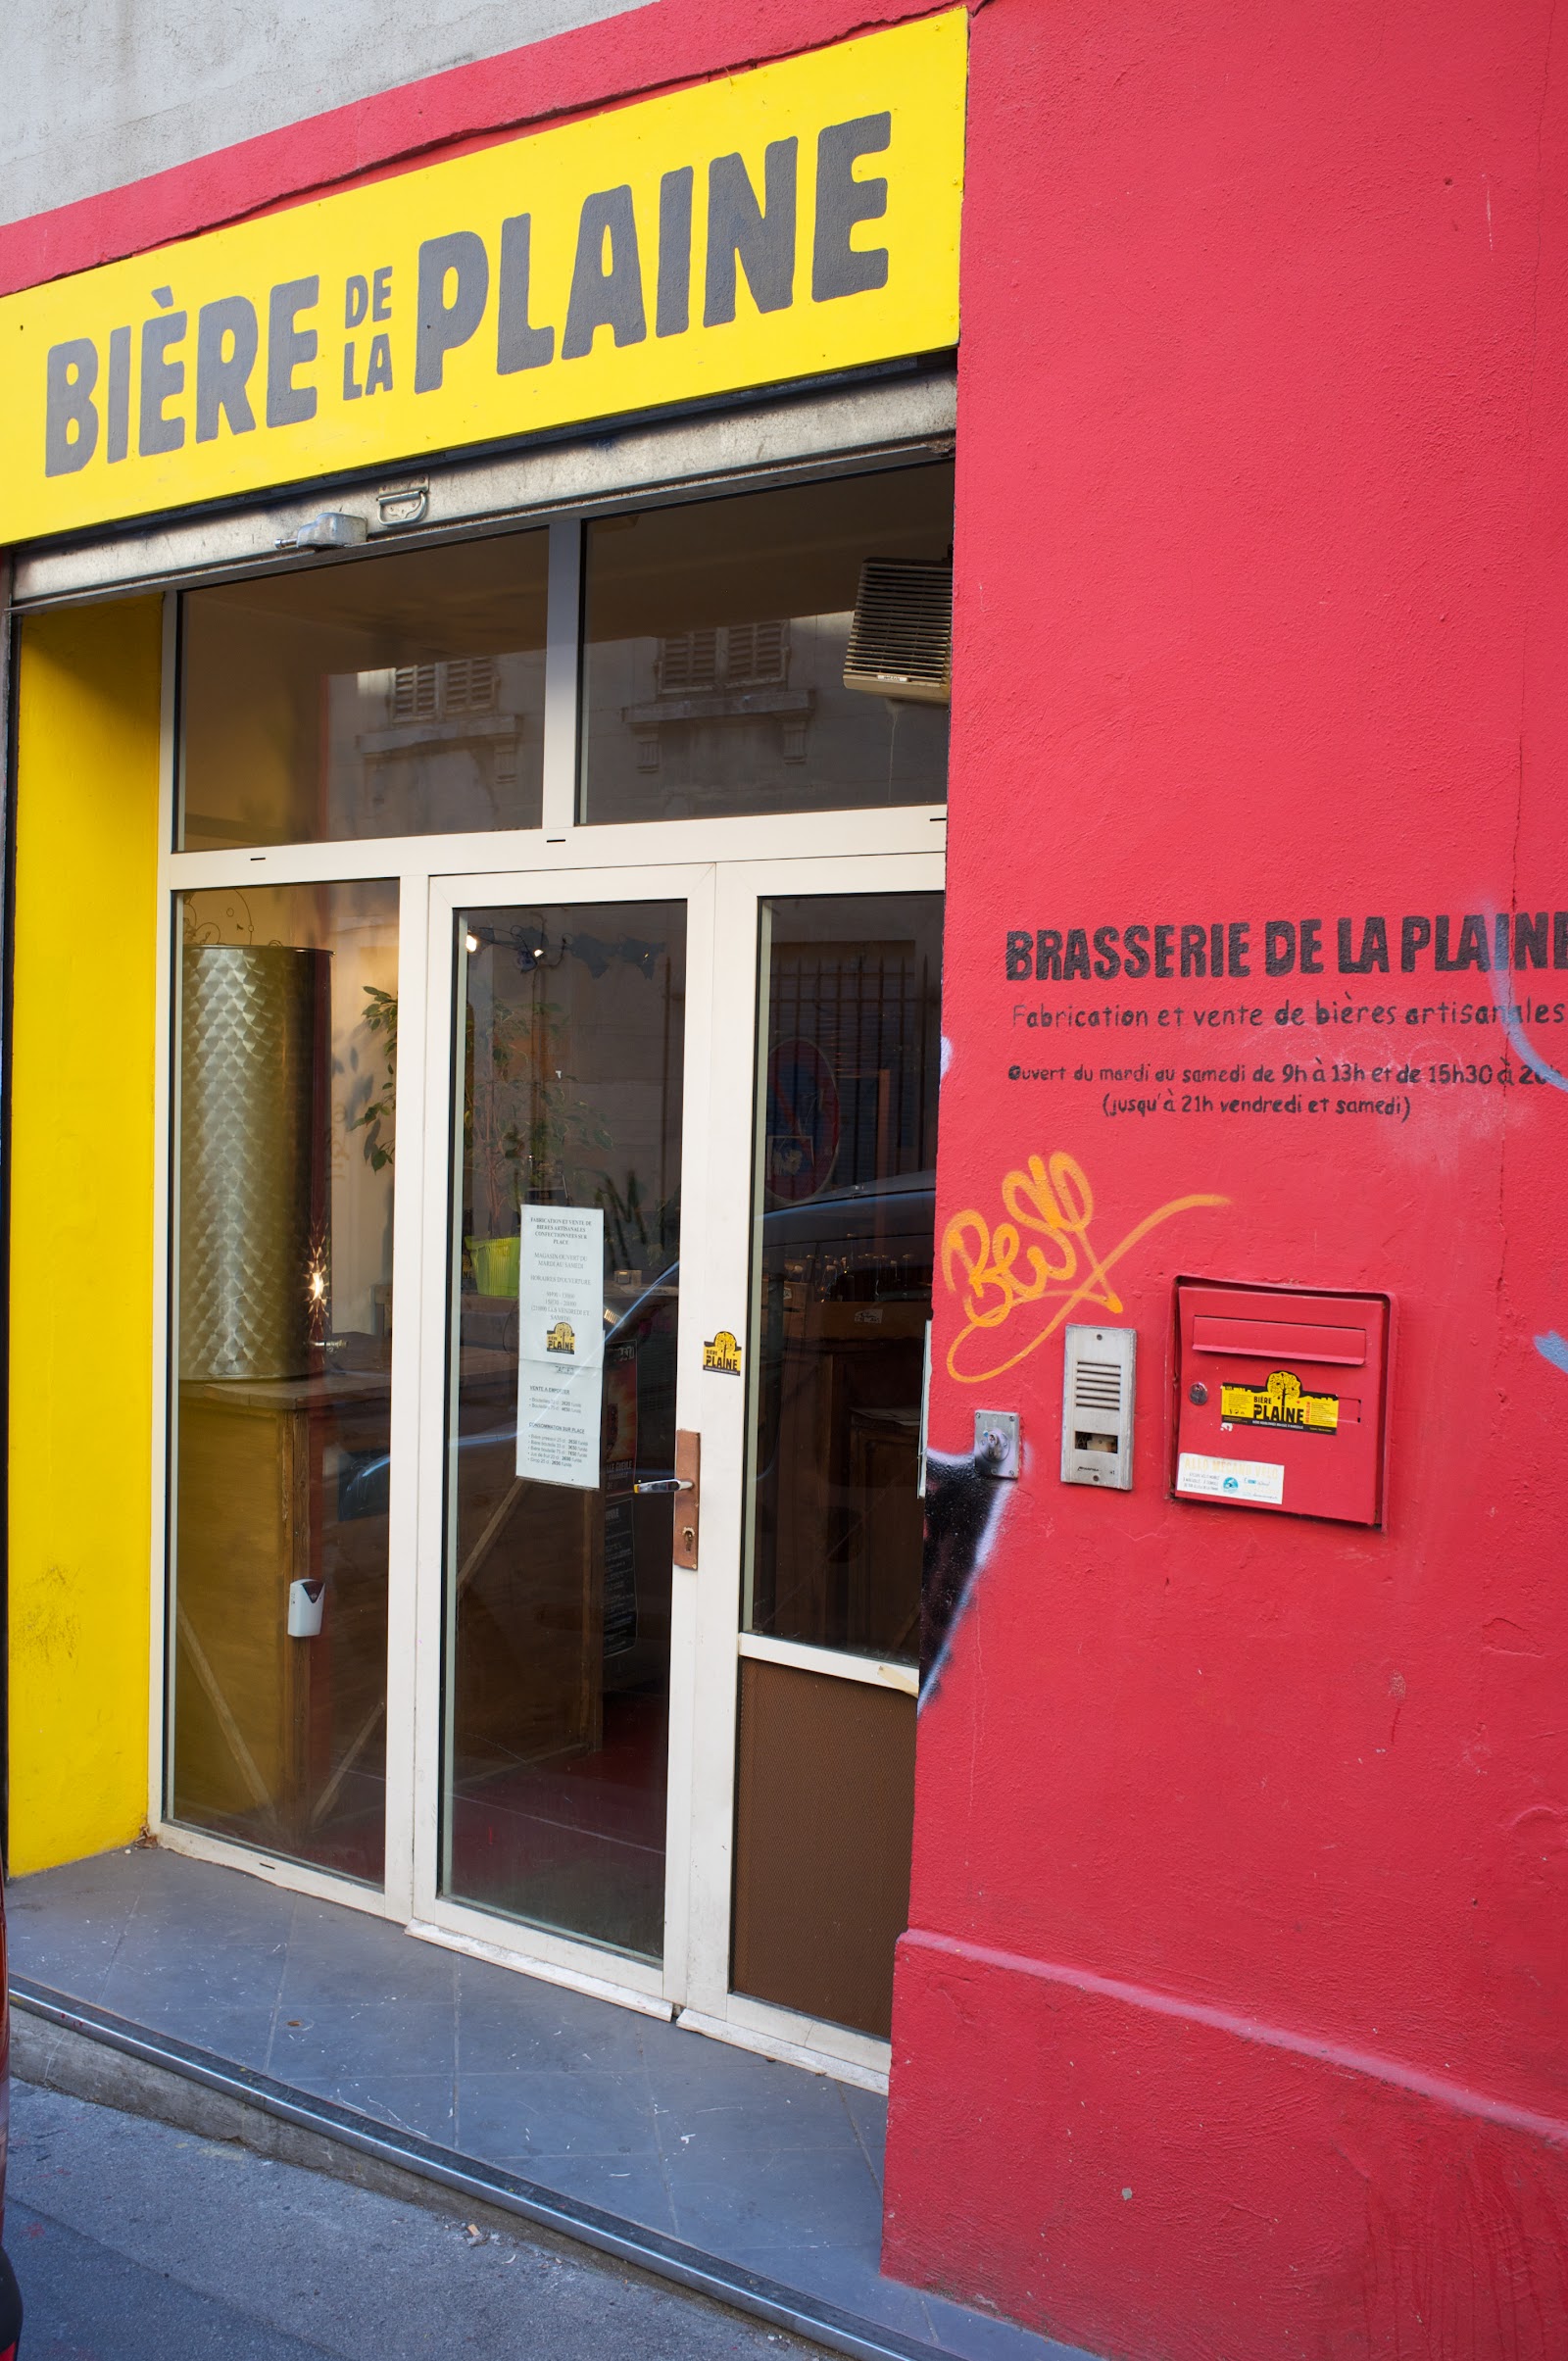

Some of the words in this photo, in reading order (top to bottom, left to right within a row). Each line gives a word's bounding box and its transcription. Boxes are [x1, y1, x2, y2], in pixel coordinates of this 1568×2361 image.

[414, 112, 893, 393] PLAINE
[344, 266, 393, 329] DE
[44, 275, 320, 478] BIÈRE
[342, 334, 393, 402] LA
[1005, 922, 1250, 981] BRASSERIE
[1264, 918, 1324, 976] DE
[1337, 915, 1390, 974] LA
[1012, 1004, 1149, 1028] Fabrication
[1157, 1007, 1185, 1027] et
[1194, 1006, 1263, 1027] vente
[1274, 999, 1304, 1025] de
[1316, 991, 1396, 1025] bières
[1405, 996, 1565, 1025] artisanales
[1008, 1064, 1066, 1081] Ouvert
[1074, 1062, 1094, 1082] du
[1100, 1062, 1152, 1083] mardi
[1154, 1067, 1175, 1083] au
[1182, 1063, 1246, 1083] samedi
[1252, 1063, 1275, 1083] de
[1282, 1063, 1307, 1084] 9h
[1311, 1057, 1326, 1083] à
[1331, 1063, 1366, 1083] 13h
[1372, 1066, 1393, 1083] et
[1396, 1064, 1422, 1084] de
[1428, 1063, 1494, 1085] 15h30
[1181, 1095, 1214, 1113] 21h
[1220, 1094, 1302, 1114] vendredi
[1308, 1097, 1329, 1114] et
[1336, 1096, 1411, 1123] samedi)
[548, 1340, 574, 1351] PLAINE
[706, 1355, 738, 1370] PLAINE
[1253, 1396, 1272, 1404] BIÈRE
[1253, 1403, 1304, 1425] PLAINE
